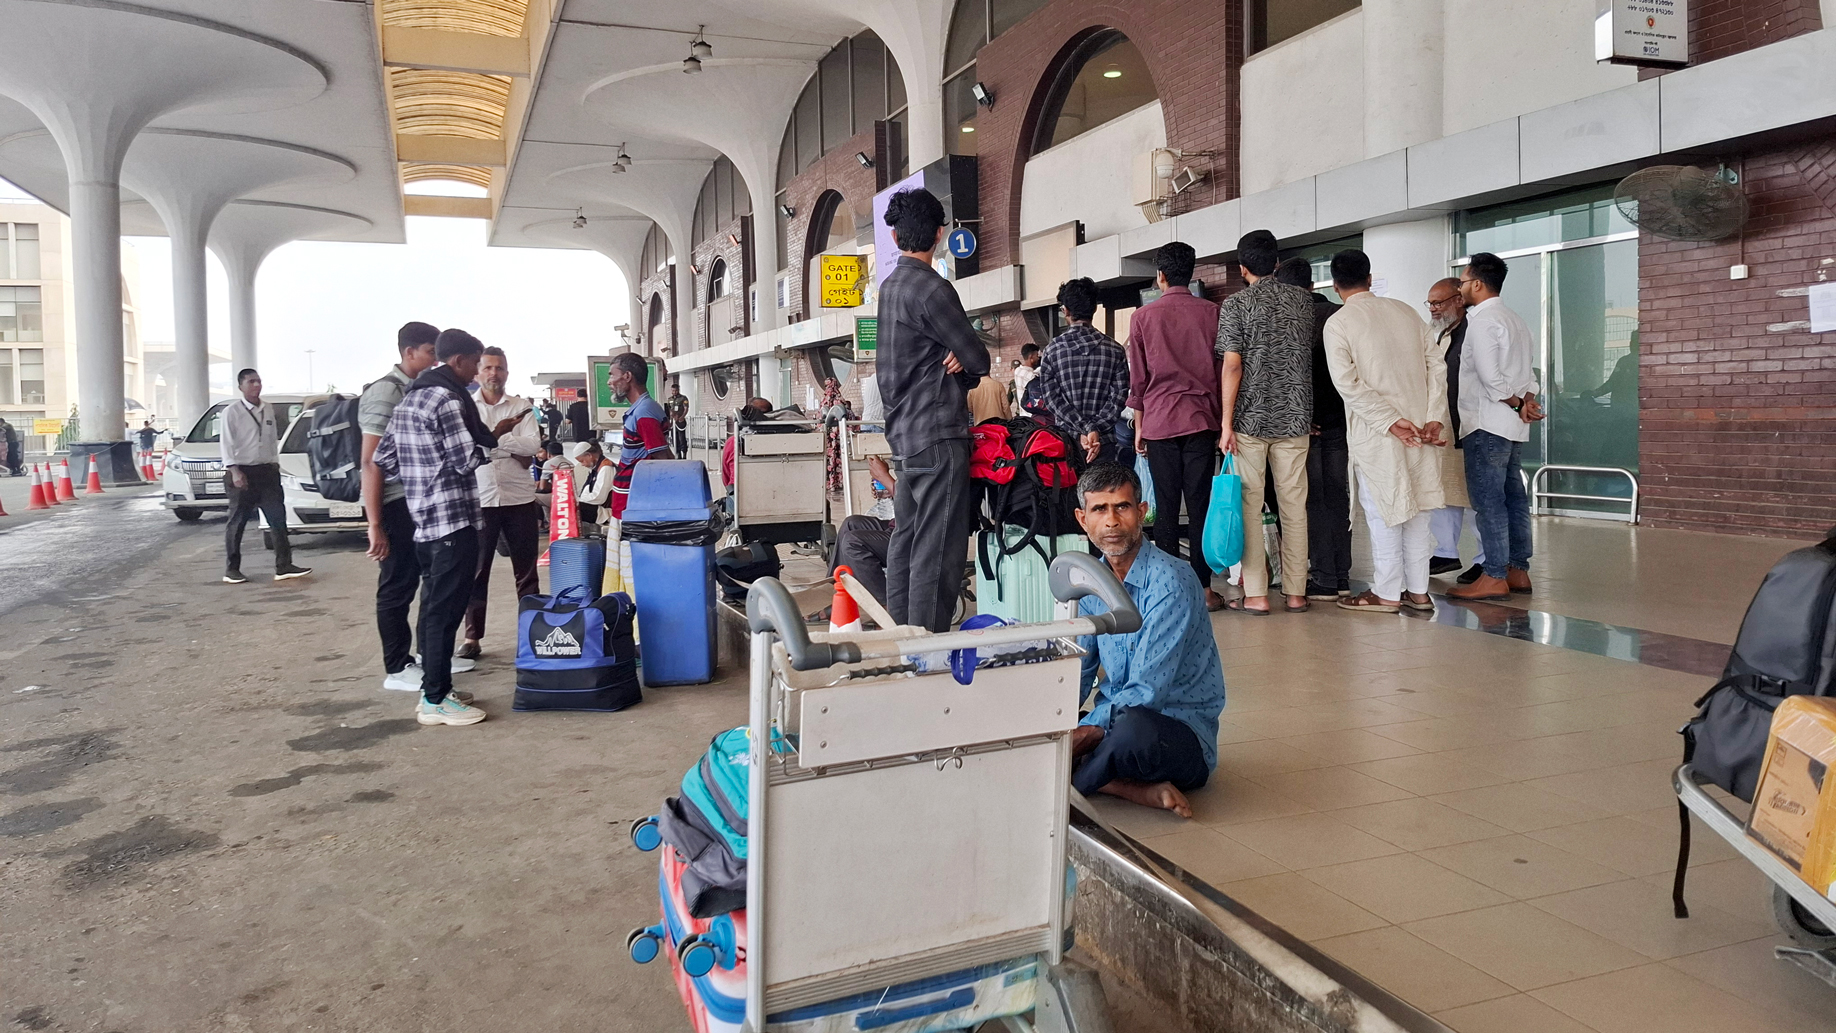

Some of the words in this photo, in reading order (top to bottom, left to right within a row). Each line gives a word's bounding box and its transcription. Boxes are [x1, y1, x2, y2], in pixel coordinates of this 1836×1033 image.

[955, 233, 969, 253] 1
[828, 264, 857, 272] GATE
[835, 273, 848, 281] 01
[556, 478, 570, 540] WALTON
[535, 646, 582, 655] WILLPOWER
